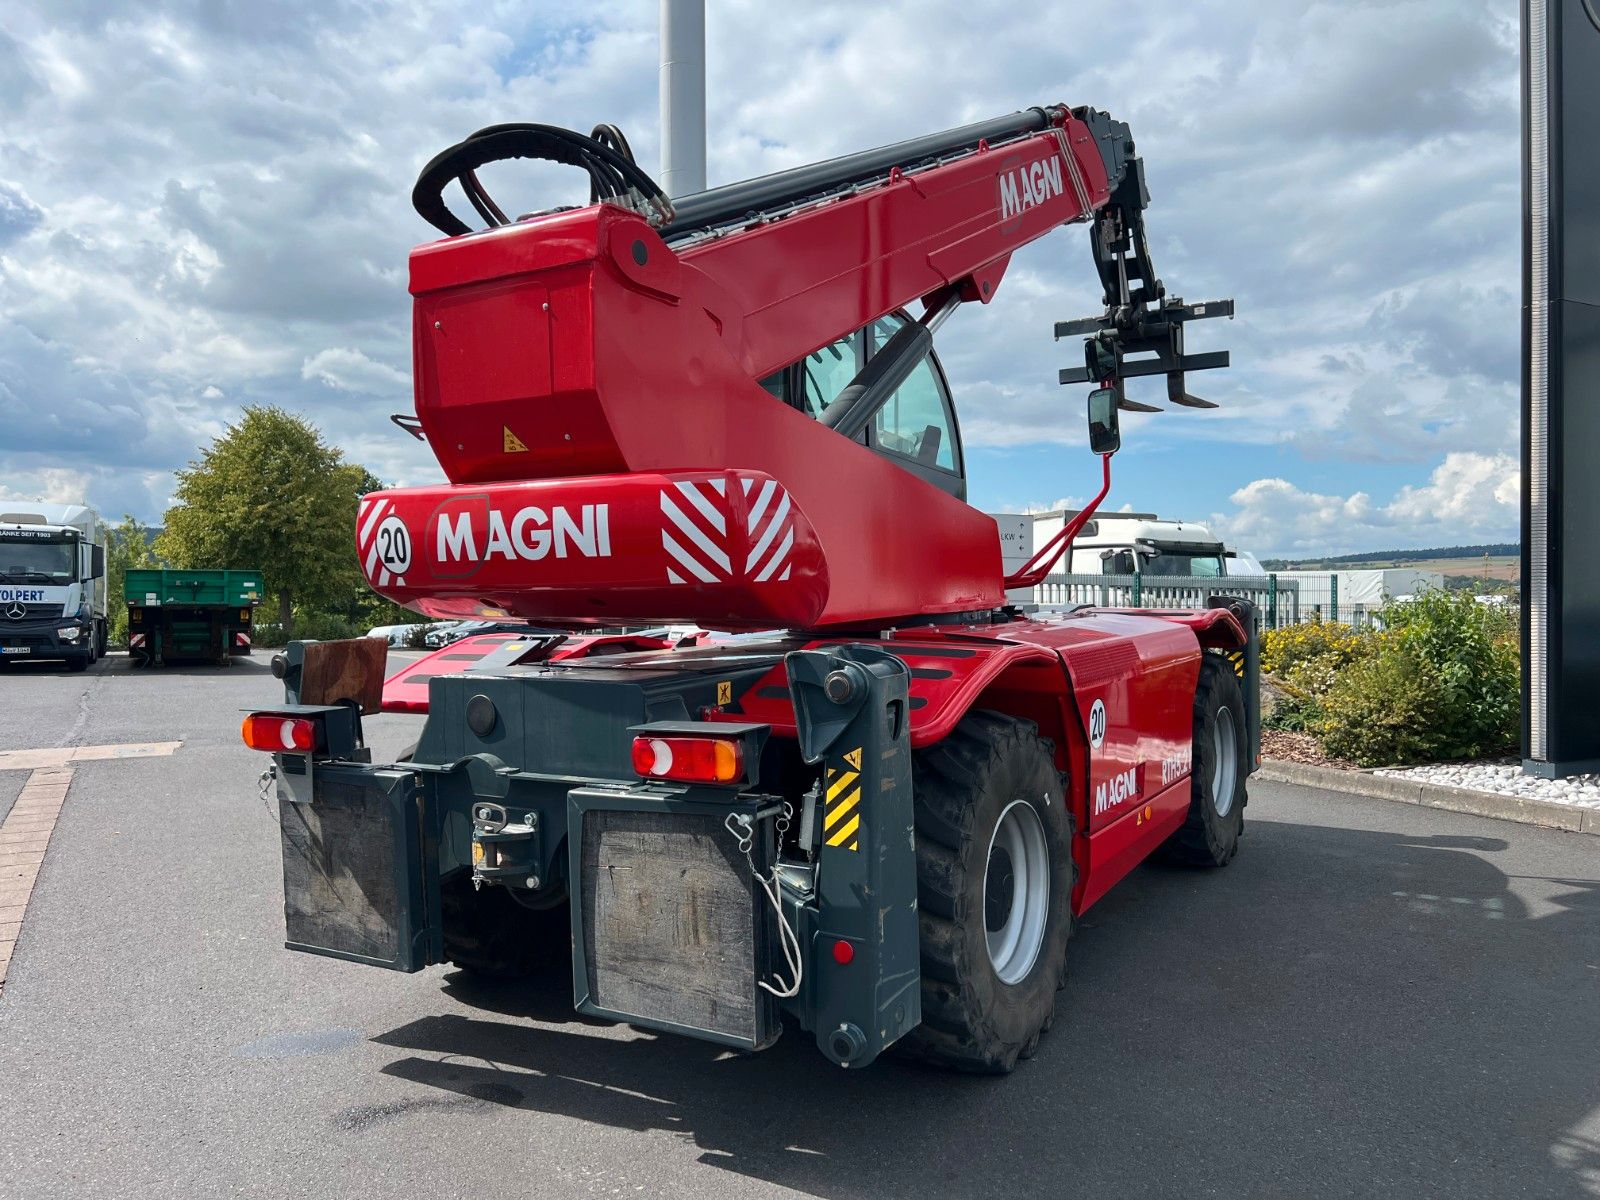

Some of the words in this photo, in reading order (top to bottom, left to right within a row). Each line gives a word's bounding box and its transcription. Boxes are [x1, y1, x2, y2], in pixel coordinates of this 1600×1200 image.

[999, 155, 1064, 219] MAGNI
[380, 527, 407, 564] 20
[436, 503, 612, 562] MAGNI
[1001, 533, 1015, 541] LKW
[1091, 706, 1104, 741] 20
[1095, 767, 1137, 816] MAGNI
